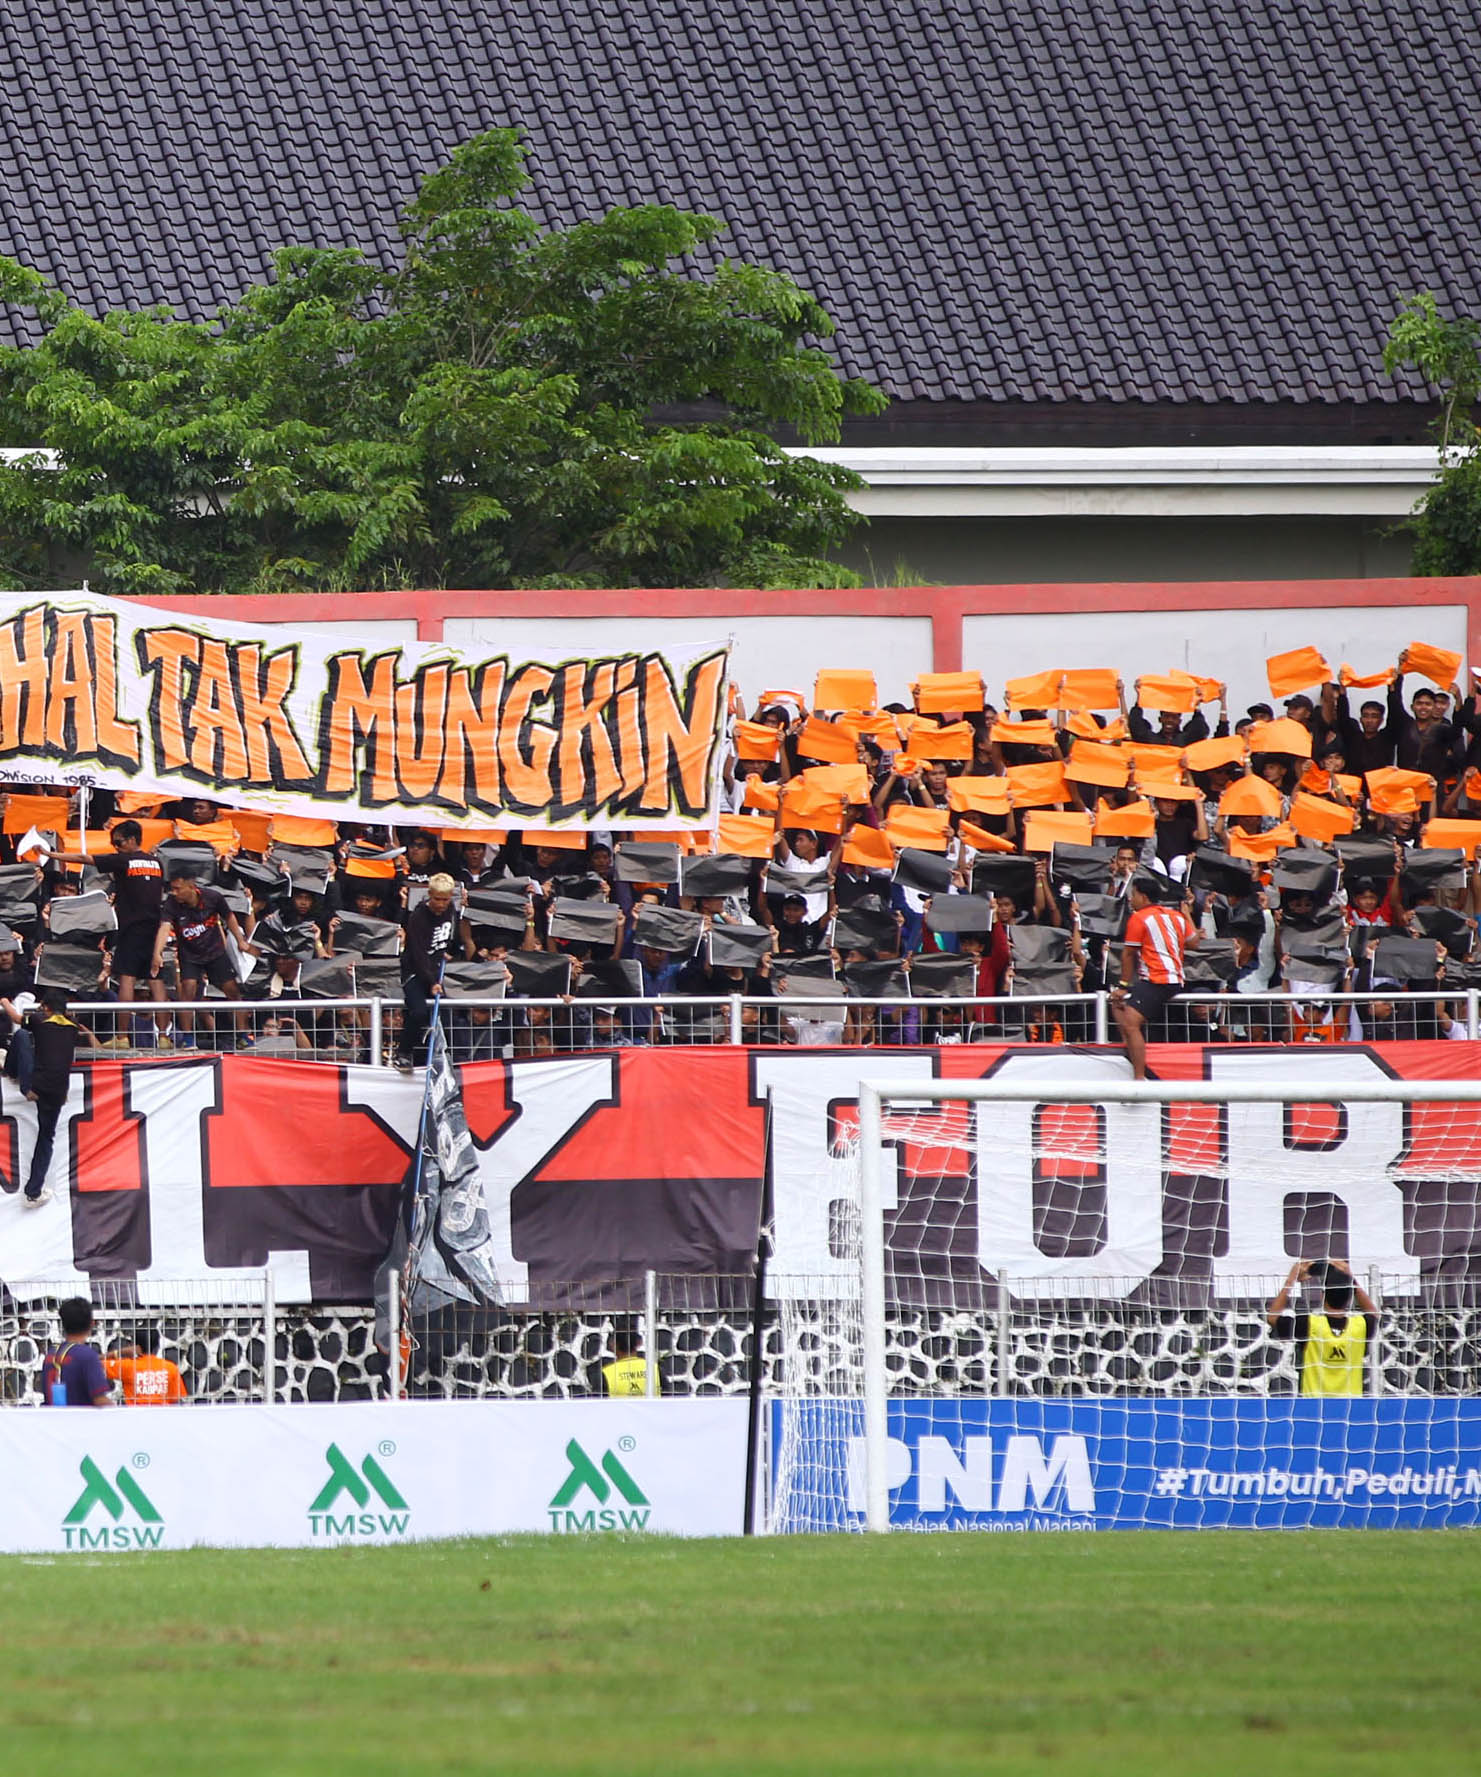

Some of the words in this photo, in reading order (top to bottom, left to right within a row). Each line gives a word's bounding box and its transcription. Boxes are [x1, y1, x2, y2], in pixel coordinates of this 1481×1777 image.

[136, 627, 320, 795] TAK
[62, 774, 97, 787] 1985
[750, 1046, 1421, 1299] FOR
[848, 1436, 1096, 1512] PNM
[307, 1514, 410, 1536] TMSW
[547, 1509, 651, 1532] TMSW
[61, 1526, 165, 1549] TMSW
